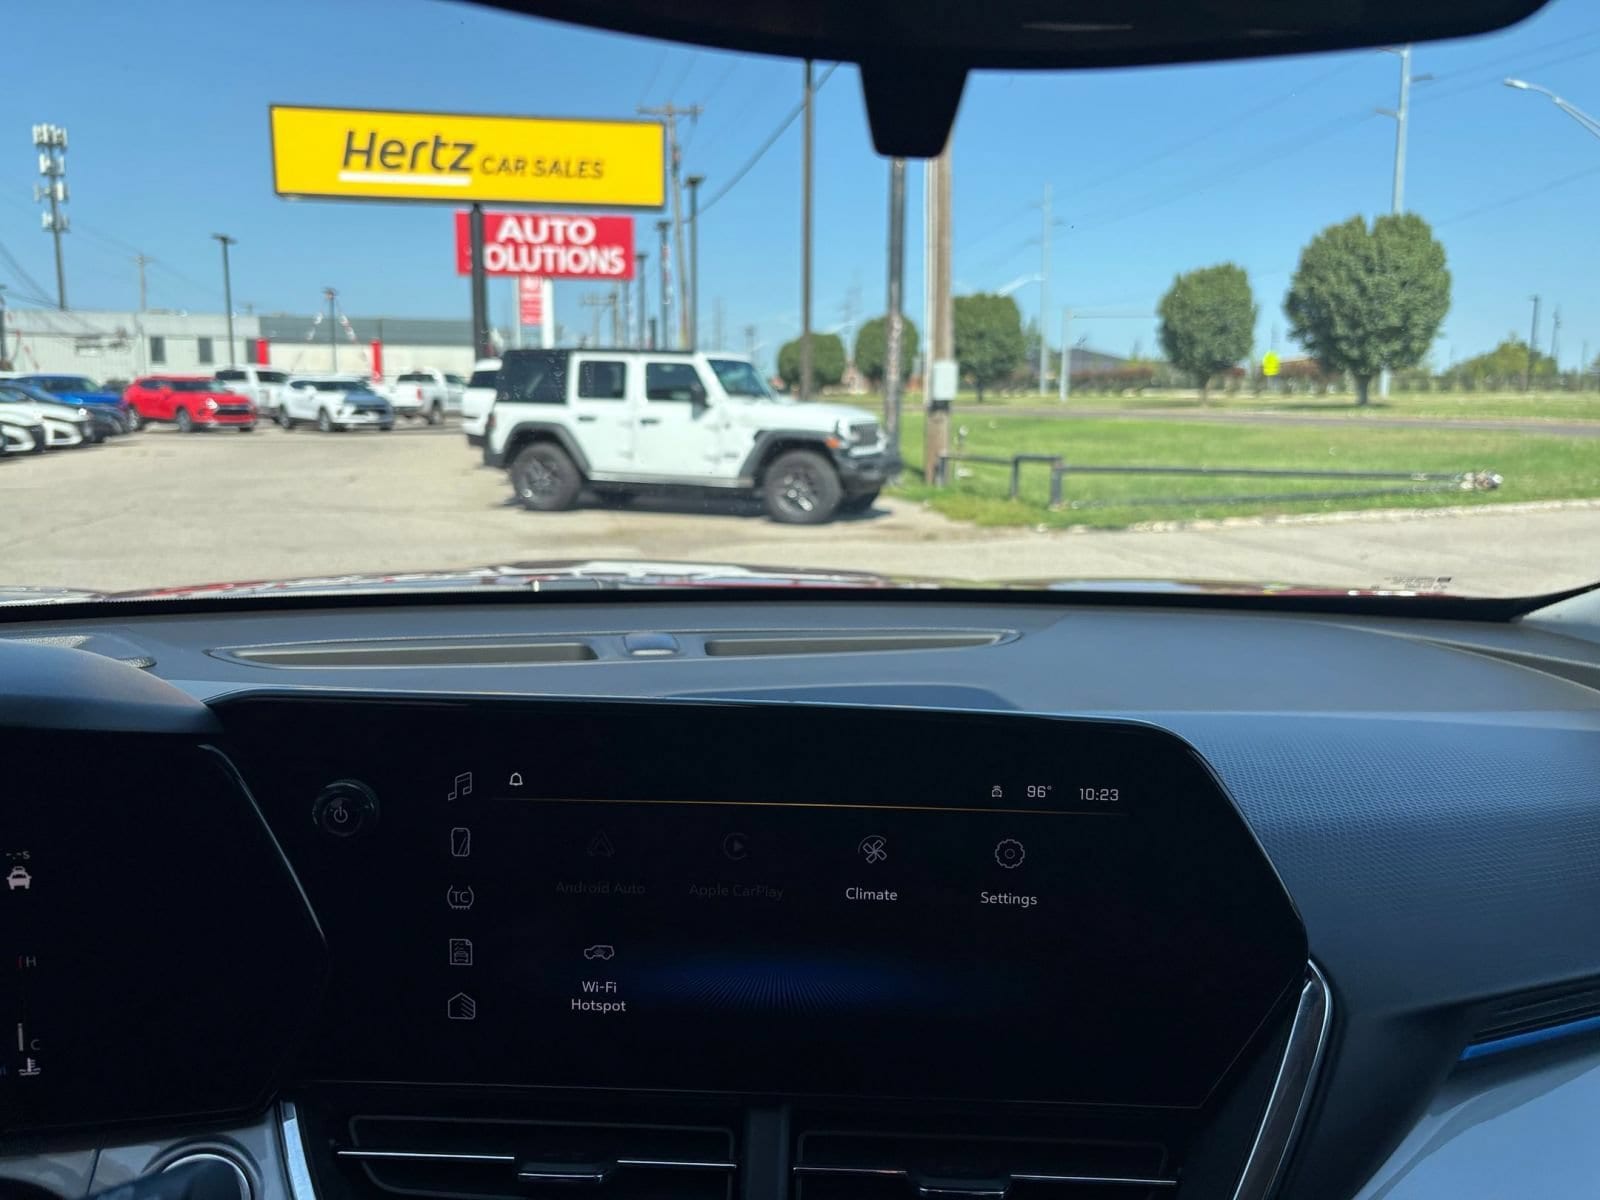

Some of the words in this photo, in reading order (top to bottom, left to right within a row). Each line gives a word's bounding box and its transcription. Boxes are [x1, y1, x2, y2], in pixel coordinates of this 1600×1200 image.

[343, 130, 476, 172] Hertz
[480, 156, 528, 176] CAR
[533, 158, 604, 179] SALES
[497, 216, 596, 246] AUTO
[465, 244, 626, 275] OLUTIONS
[1080, 788, 1119, 801] 10:23
[555, 881, 609, 895] Android
[613, 882, 646, 895] Auto
[689, 884, 729, 900] Apple
[732, 884, 784, 901] CarPlay
[845, 887, 898, 901] Climate
[980, 891, 1038, 908] Settings
[582, 980, 617, 993] Wi-Fi
[571, 998, 627, 1014] Hotspot
